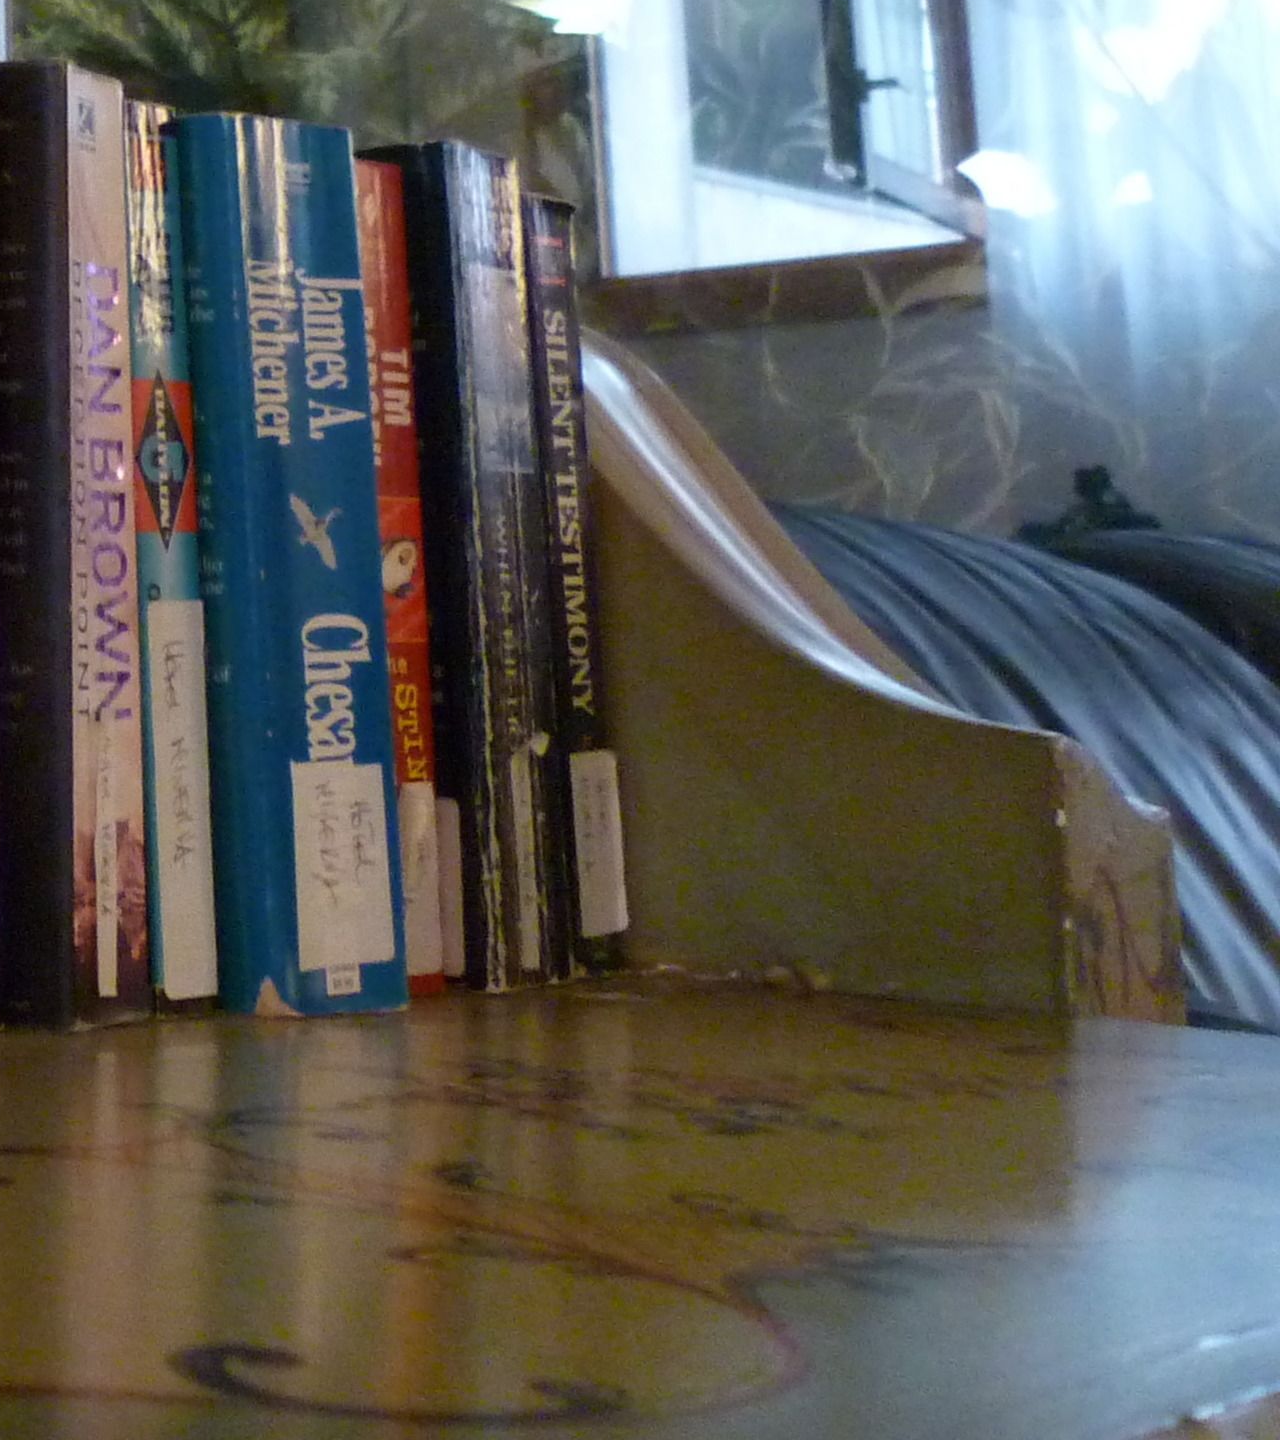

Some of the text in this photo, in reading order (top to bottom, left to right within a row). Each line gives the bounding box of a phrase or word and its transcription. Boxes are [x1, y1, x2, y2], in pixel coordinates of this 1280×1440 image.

[87, 261, 122, 416] DAN
[247, 259, 300, 445] Michener
[295, 268, 363, 390] James
[380, 348, 411, 427] TIM
[89, 437, 132, 722] BROWN
[543, 309, 595, 715] SILENT TESTIMONY
[301, 613, 373, 762] Chesa
